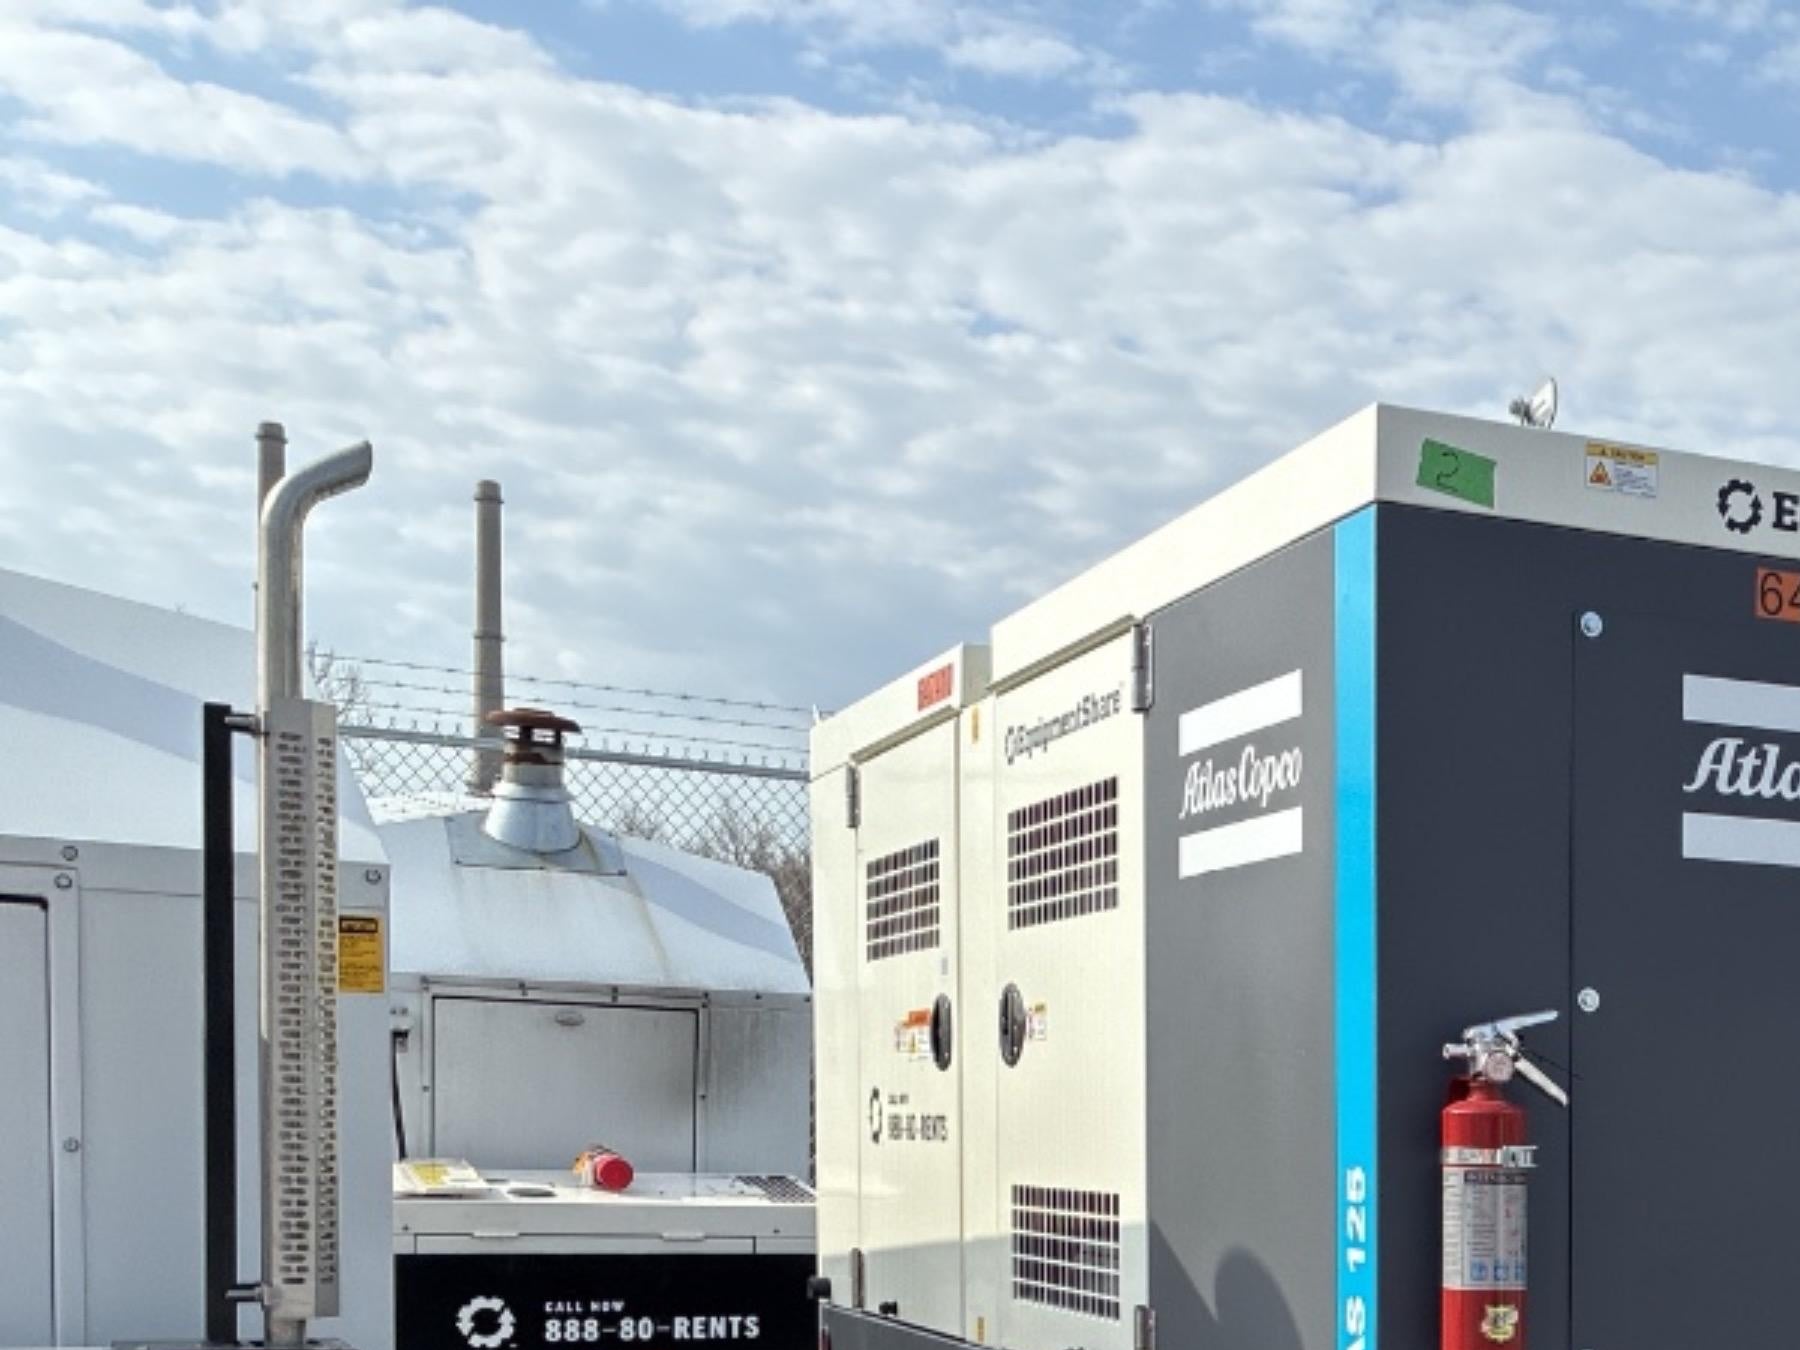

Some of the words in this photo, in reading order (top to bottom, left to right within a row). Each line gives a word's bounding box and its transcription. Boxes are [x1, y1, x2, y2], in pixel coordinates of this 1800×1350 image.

[1435, 449, 1460, 494] 2
[1178, 758, 1237, 820] Atlas
[1238, 744, 1303, 809] Copco
[1345, 1165, 1367, 1274] 125
[544, 1300, 584, 1313] CALL
[590, 1300, 625, 1313] NOW
[544, 1315, 761, 1343] 888-80-RENTS
